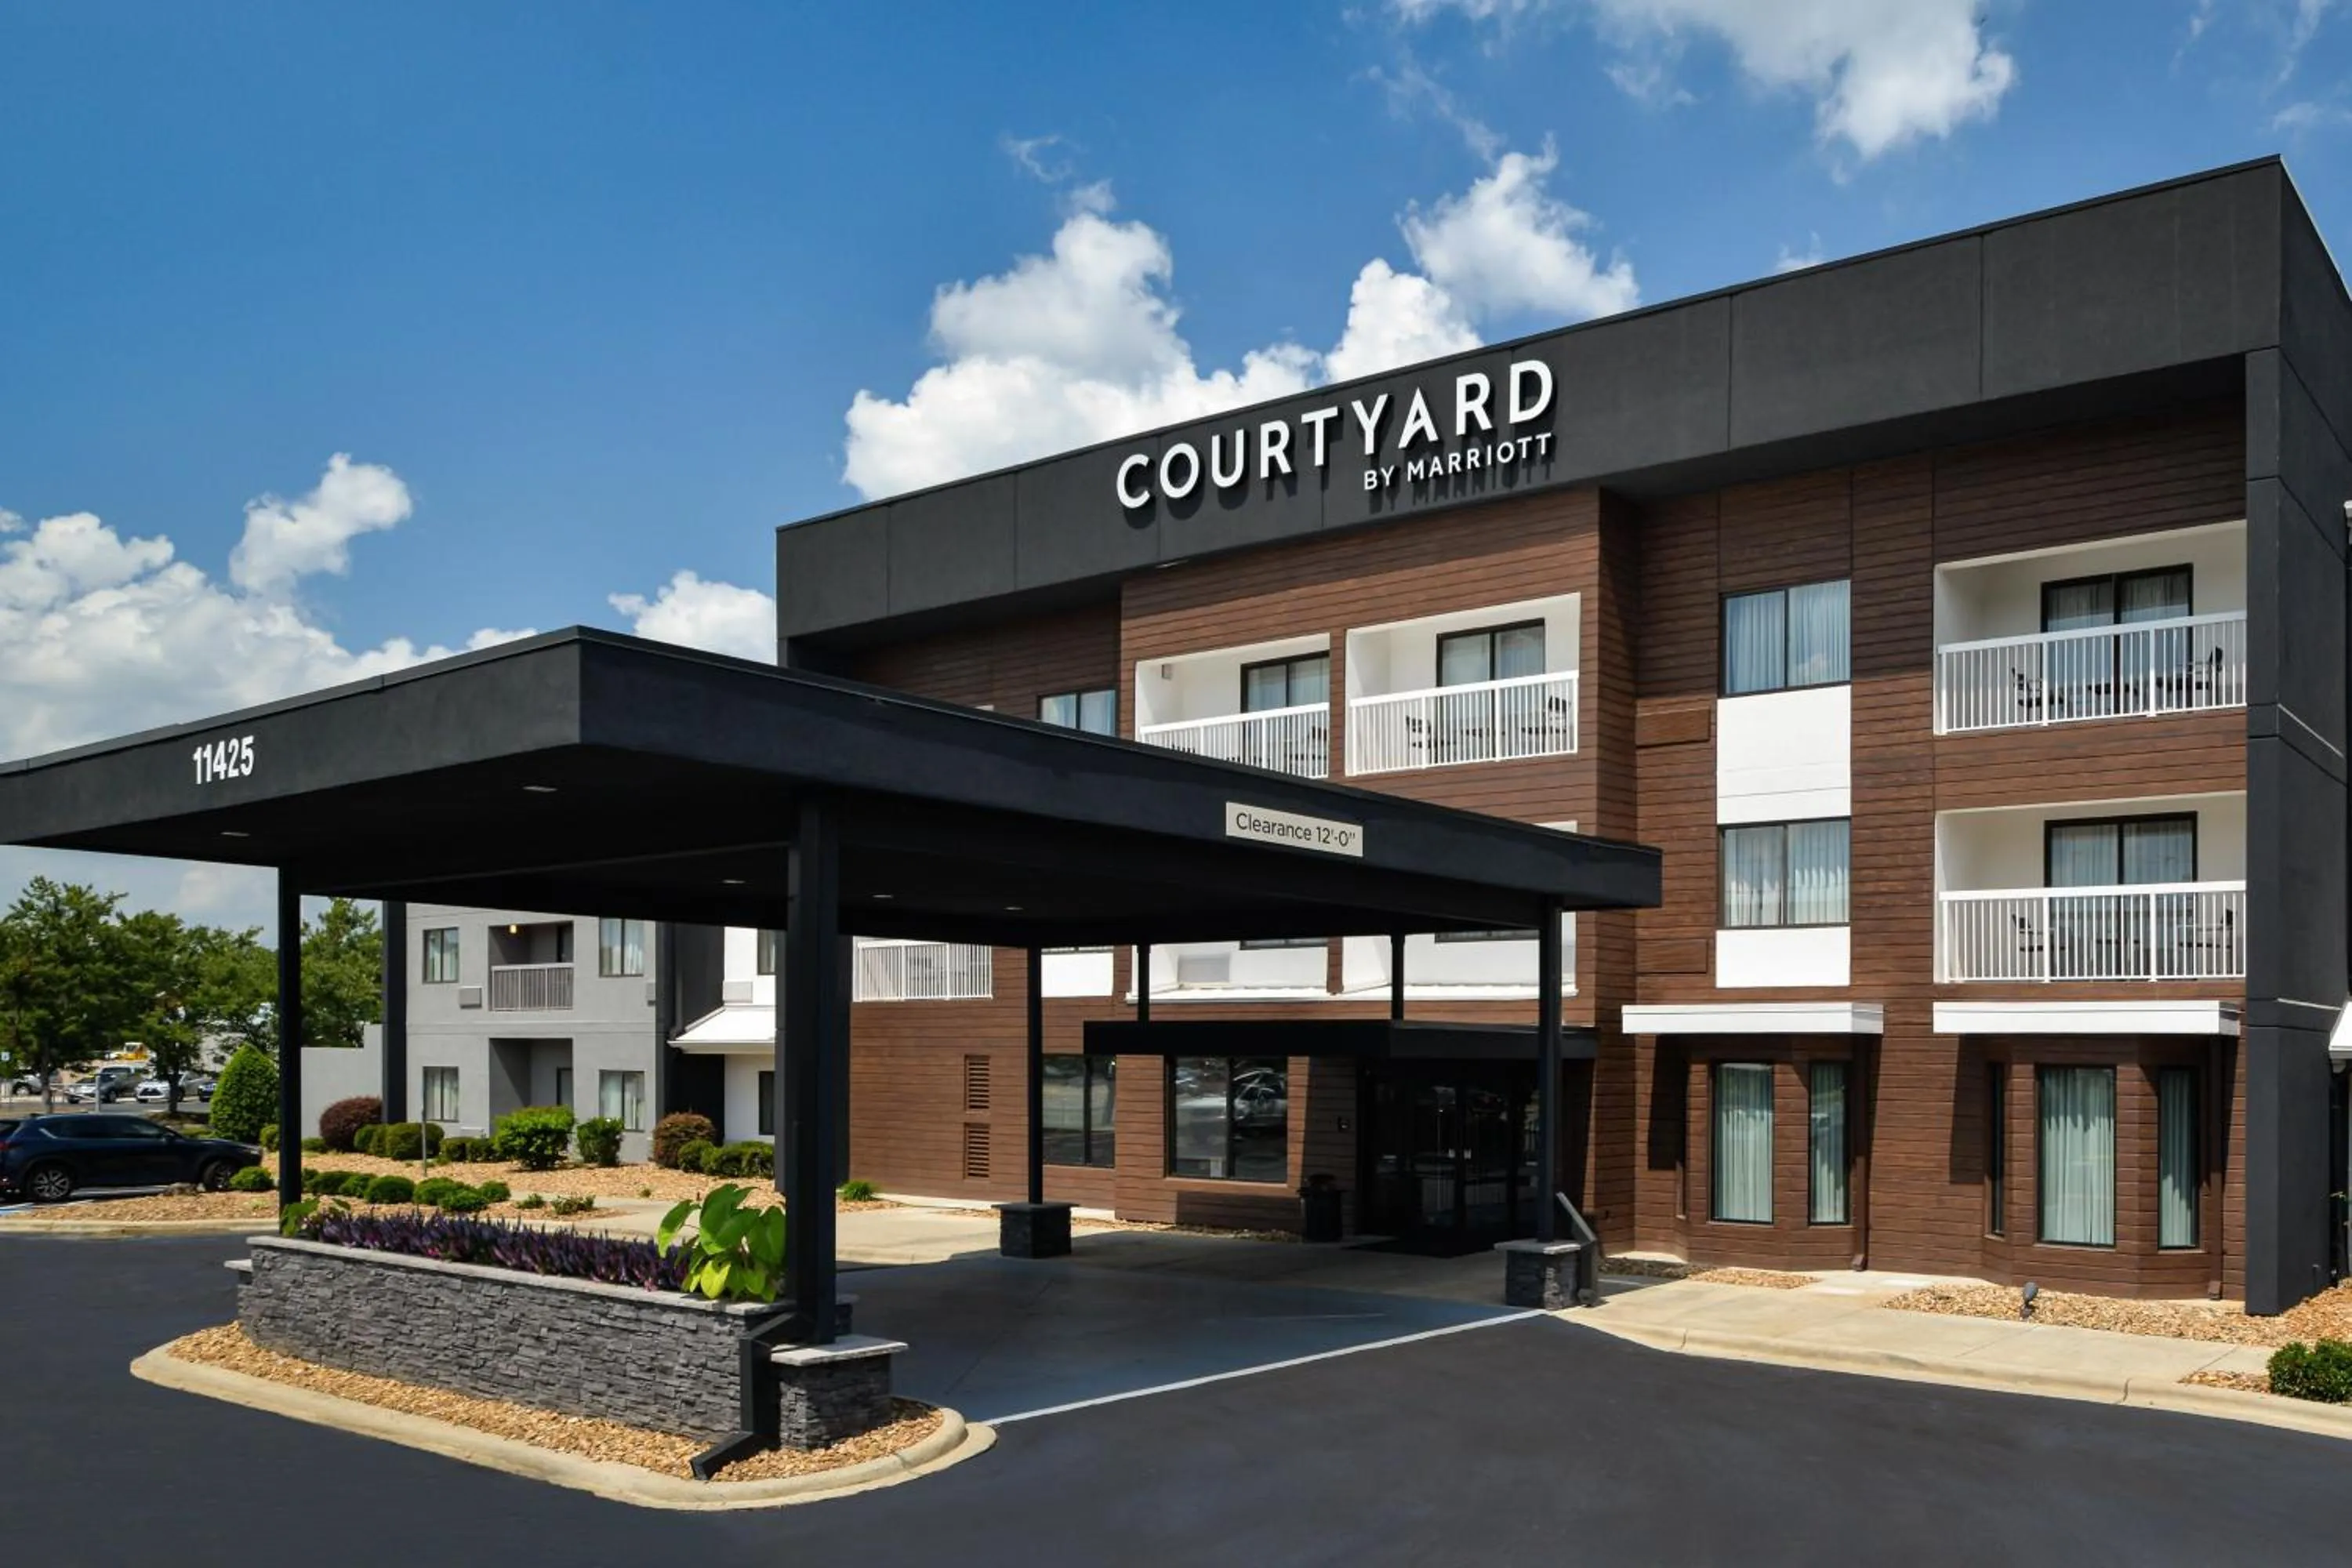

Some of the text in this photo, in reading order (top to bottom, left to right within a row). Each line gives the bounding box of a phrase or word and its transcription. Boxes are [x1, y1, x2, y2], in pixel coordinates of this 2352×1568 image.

[1116, 359, 1553, 509] COURTYARD
[1364, 432, 1552, 491] BY MARRIOTT
[193, 735, 255, 785] 11425
[1236, 812, 1312, 841] Clearance
